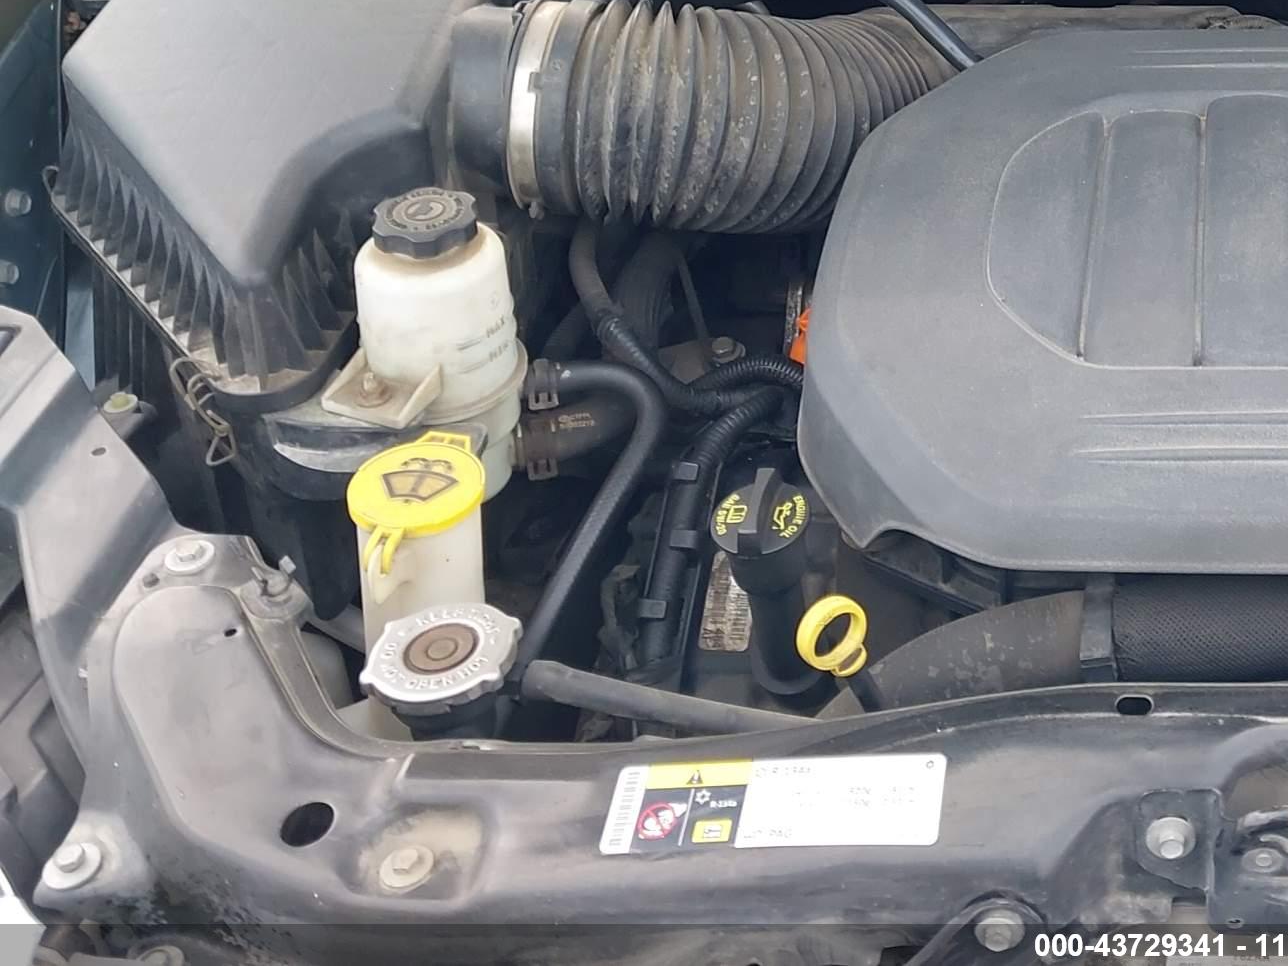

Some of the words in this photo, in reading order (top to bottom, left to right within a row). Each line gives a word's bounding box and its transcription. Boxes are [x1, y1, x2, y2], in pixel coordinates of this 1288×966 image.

[792, 495, 806, 524] ENGINE
[779, 525, 798, 538] OIL
[416, 608, 465, 627] KEEP
[380, 642, 396, 659] DO
[381, 663, 405, 683] NOT
[458, 657, 489, 680] HOT
[405, 677, 453, 690] OPEN
